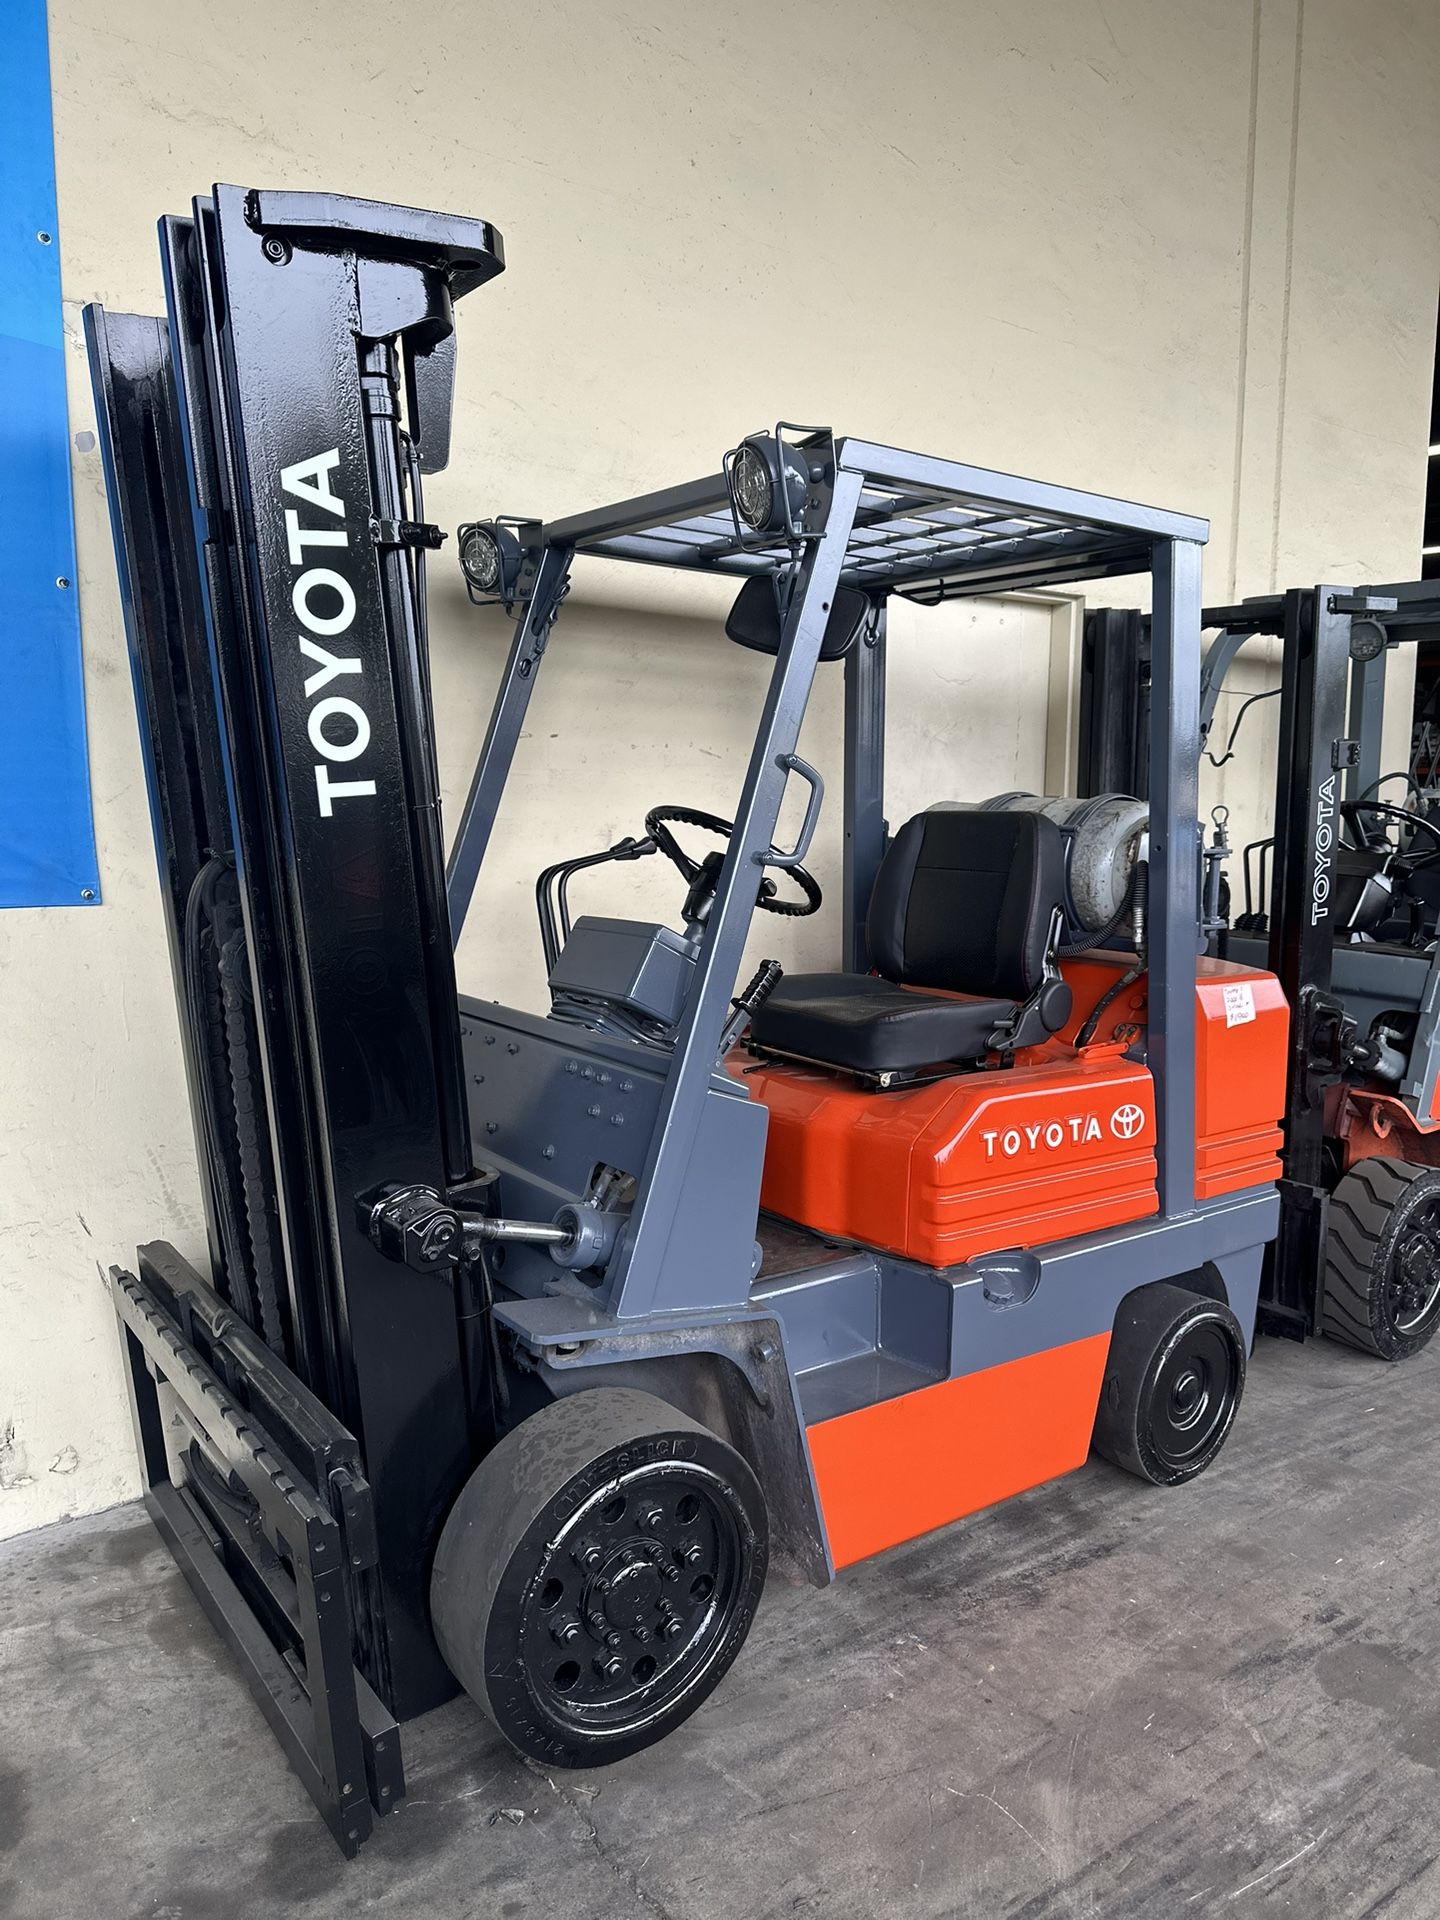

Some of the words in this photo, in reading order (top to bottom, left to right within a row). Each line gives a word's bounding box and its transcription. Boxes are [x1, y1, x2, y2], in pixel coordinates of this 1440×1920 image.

[280, 448, 377, 817] TOYOTA
[1312, 775, 1336, 926] TOYOTA
[982, 1115, 1103, 1158] TOYOTA
